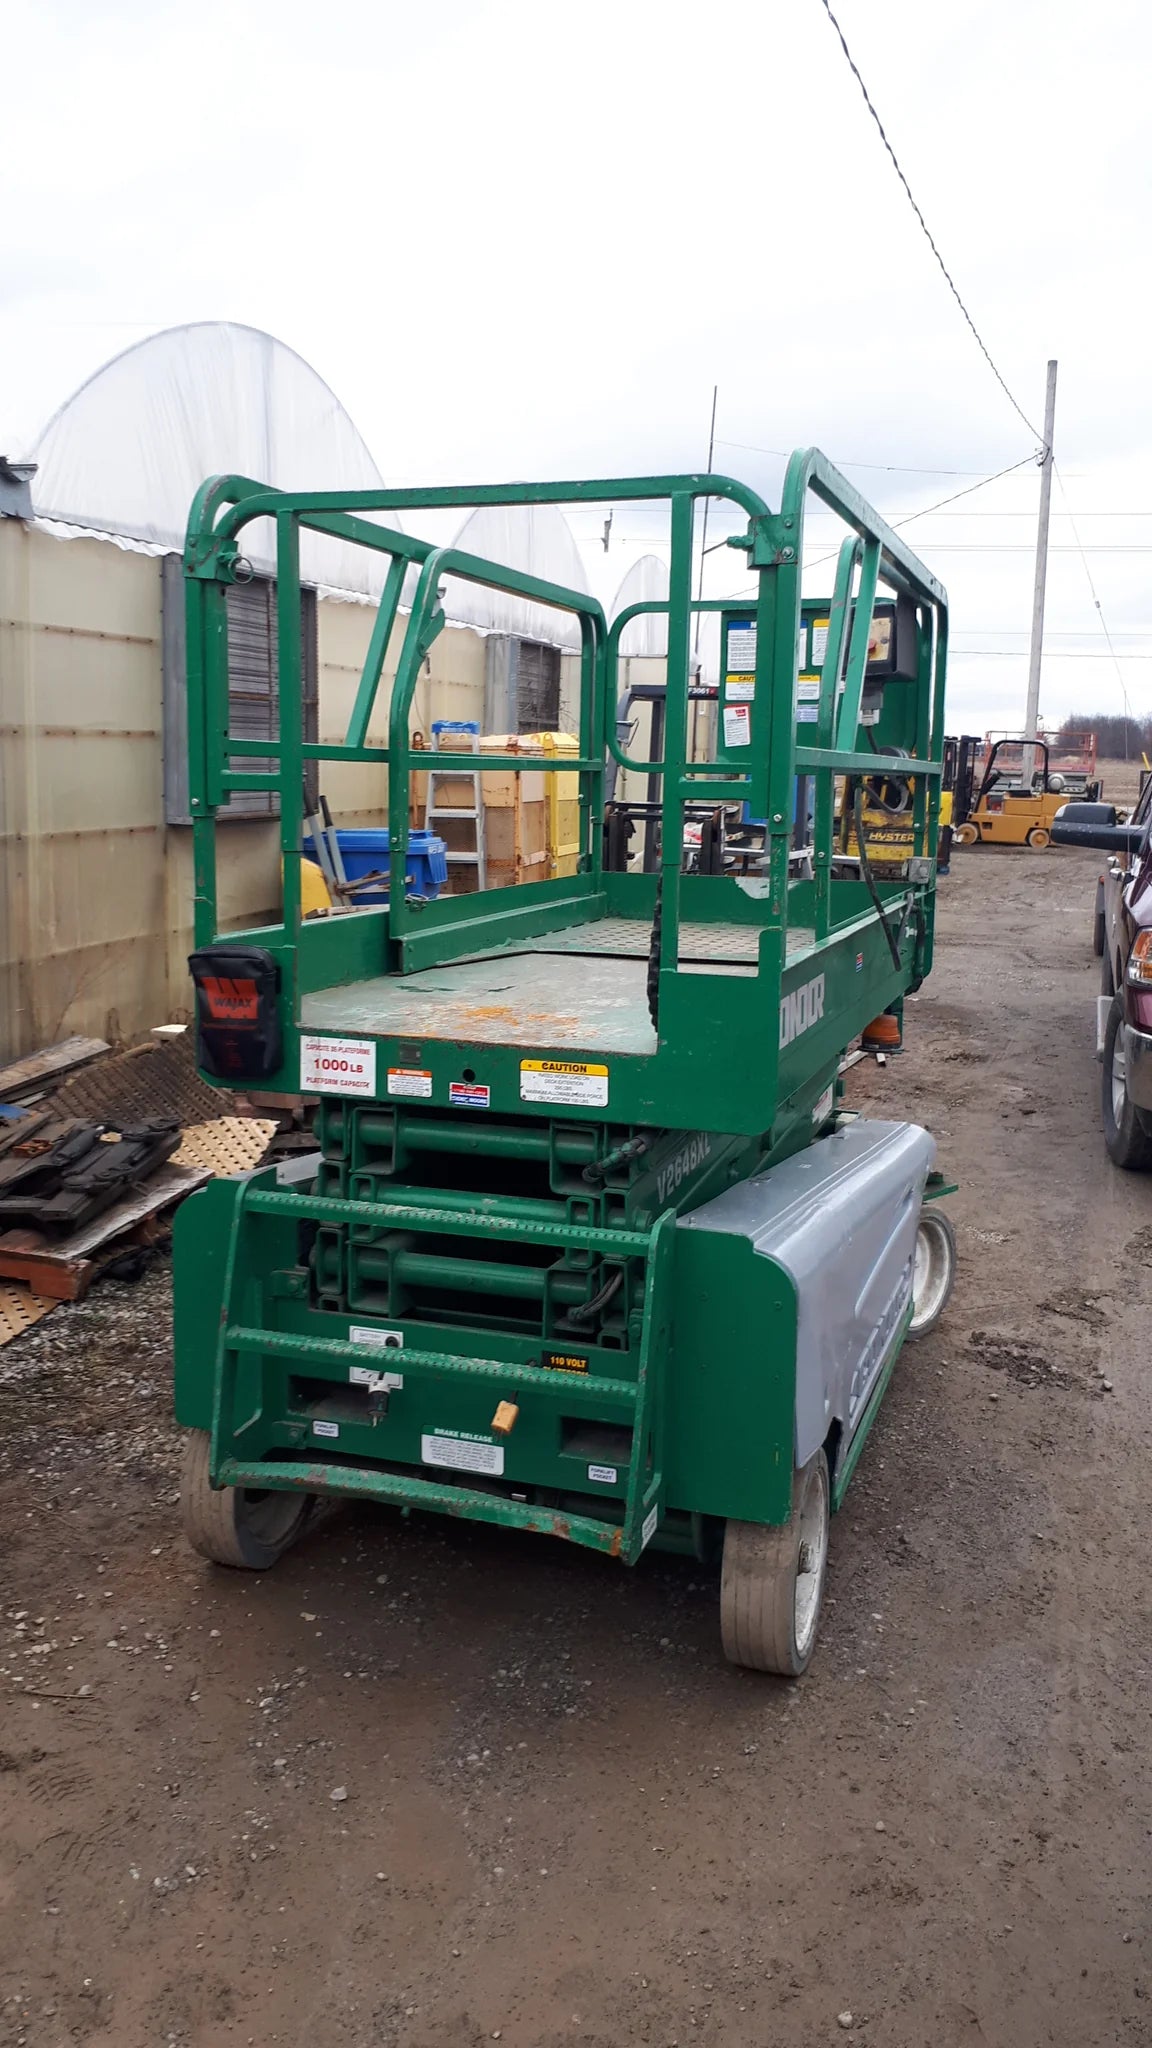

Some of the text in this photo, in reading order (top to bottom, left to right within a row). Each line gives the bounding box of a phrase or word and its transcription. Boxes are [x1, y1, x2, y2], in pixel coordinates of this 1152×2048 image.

[869, 832, 915, 842] HYSTER
[214, 997, 253, 1010] WAJAX
[314, 1059, 364, 1073] 1000 LB
[541, 1062, 587, 1073] CAUTION
[306, 1076, 338, 1085] PLATFORM
[550, 1356, 587, 1368] 110 VOLT
[434, 1428, 493, 1443] BRAKE RELEASE
